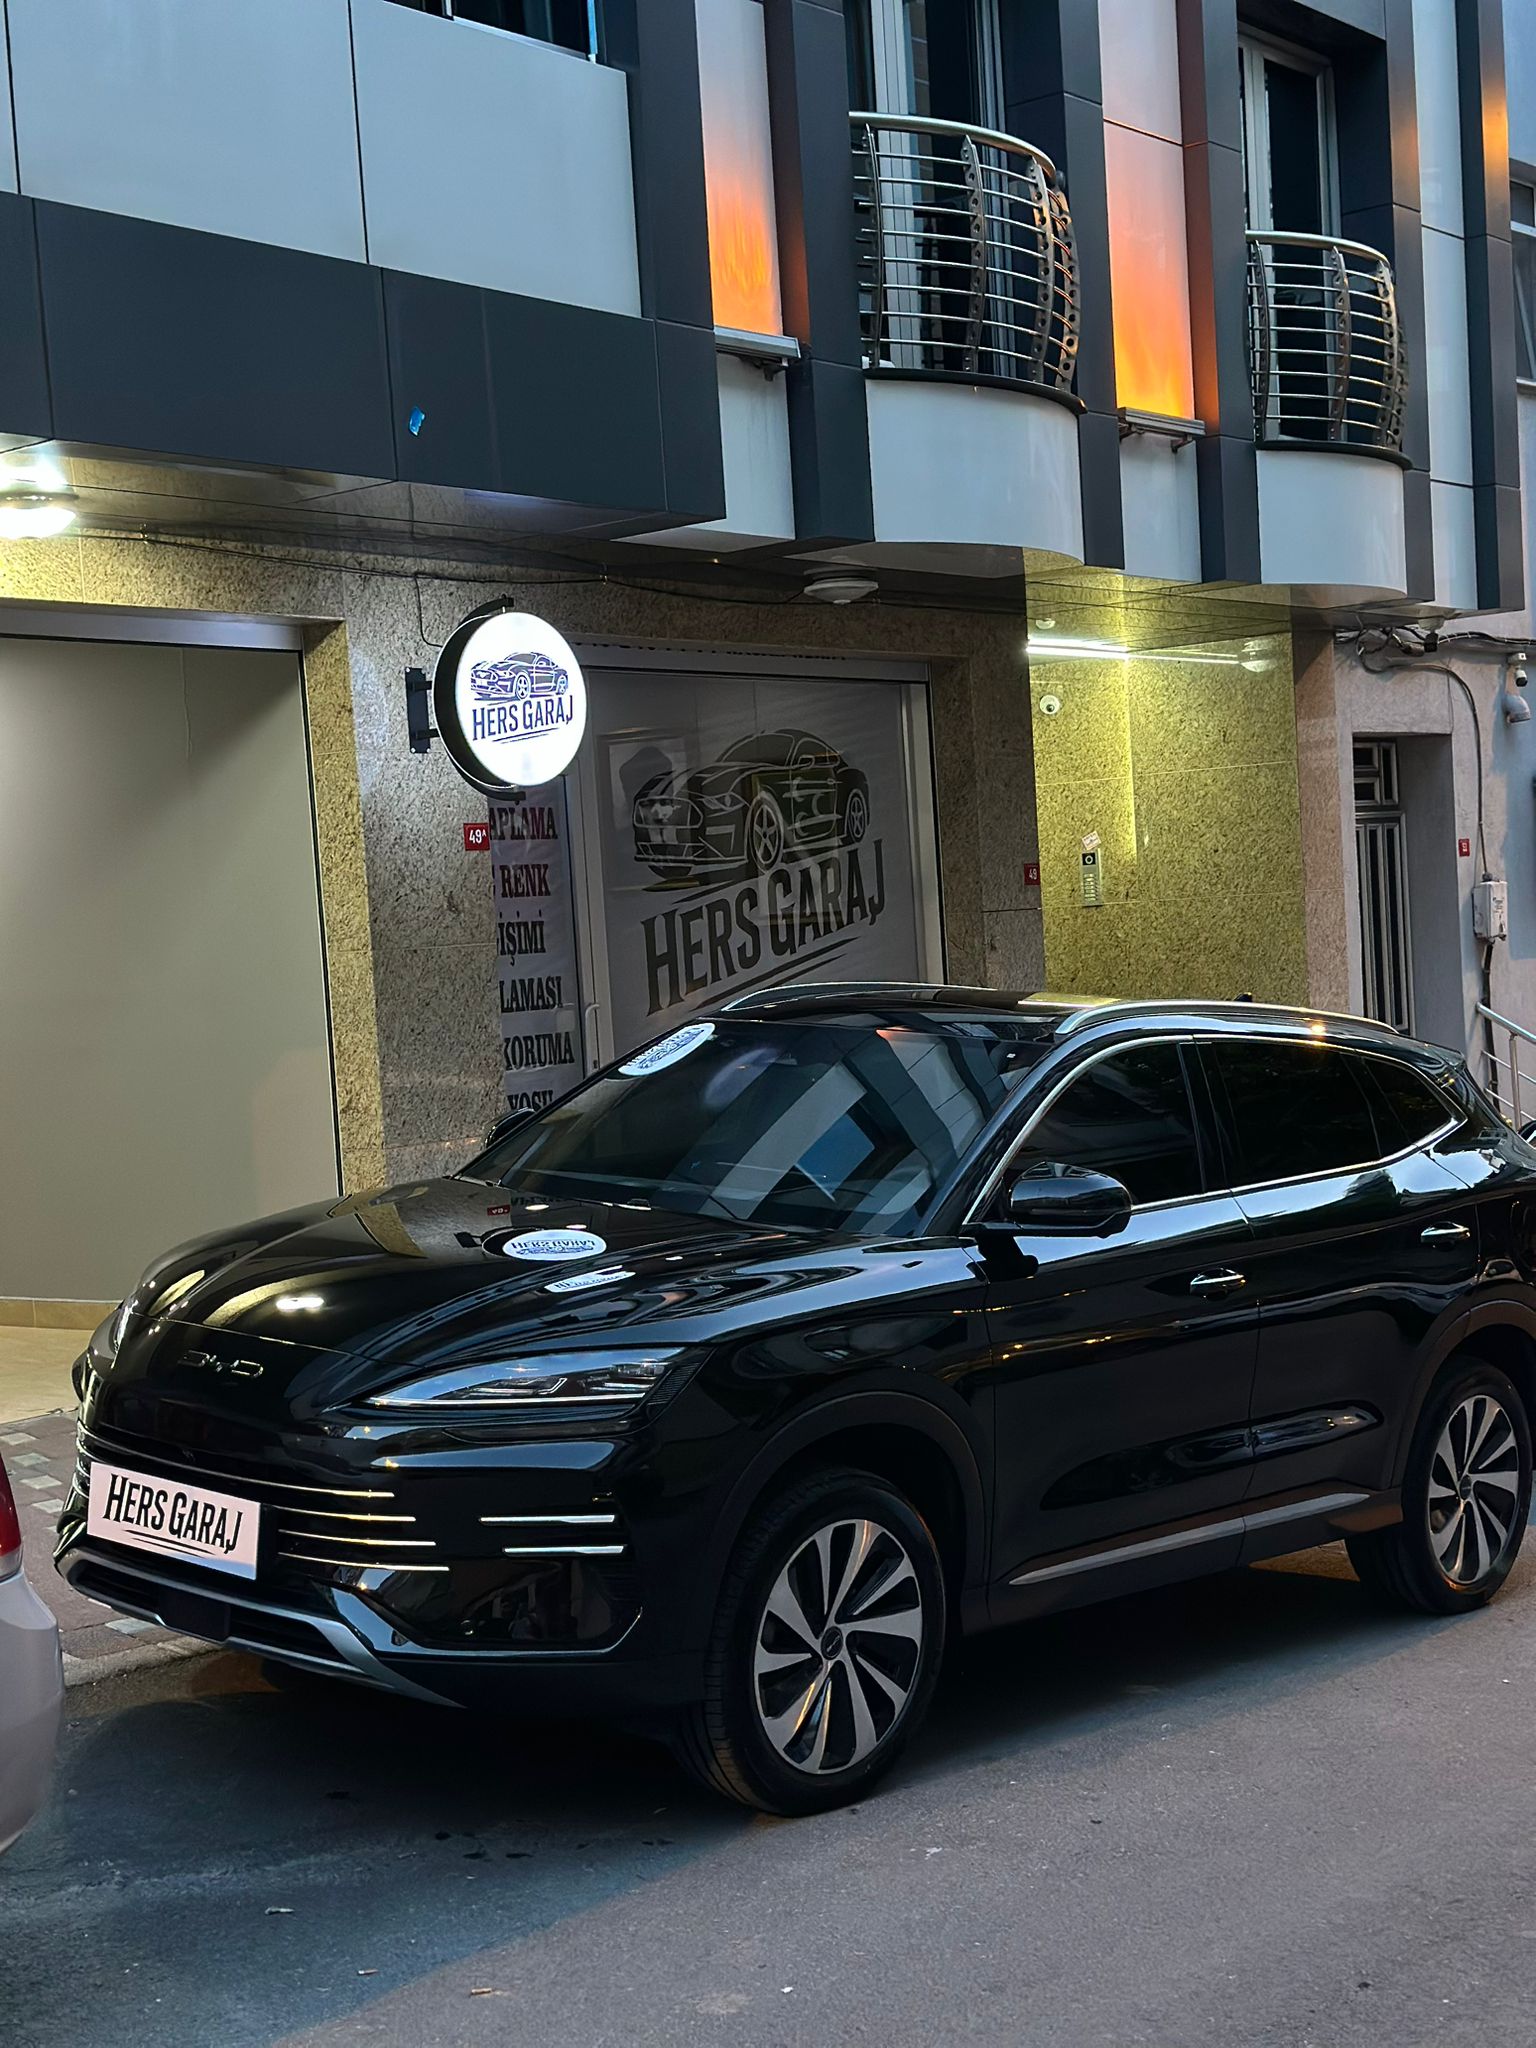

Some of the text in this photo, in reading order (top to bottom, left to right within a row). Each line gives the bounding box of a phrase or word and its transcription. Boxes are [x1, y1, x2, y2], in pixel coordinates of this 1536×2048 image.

[472, 695, 573, 741] HERS GARAJ
[499, 863, 551, 898] RENK
[497, 909, 547, 966] İŞİMİ
[640, 838, 886, 1016] HERS GARAJ
[499, 976, 563, 1013] LAMASI
[504, 1032, 575, 1071] KORUMA
[102, 1473, 243, 1554] HERS GARAJ
